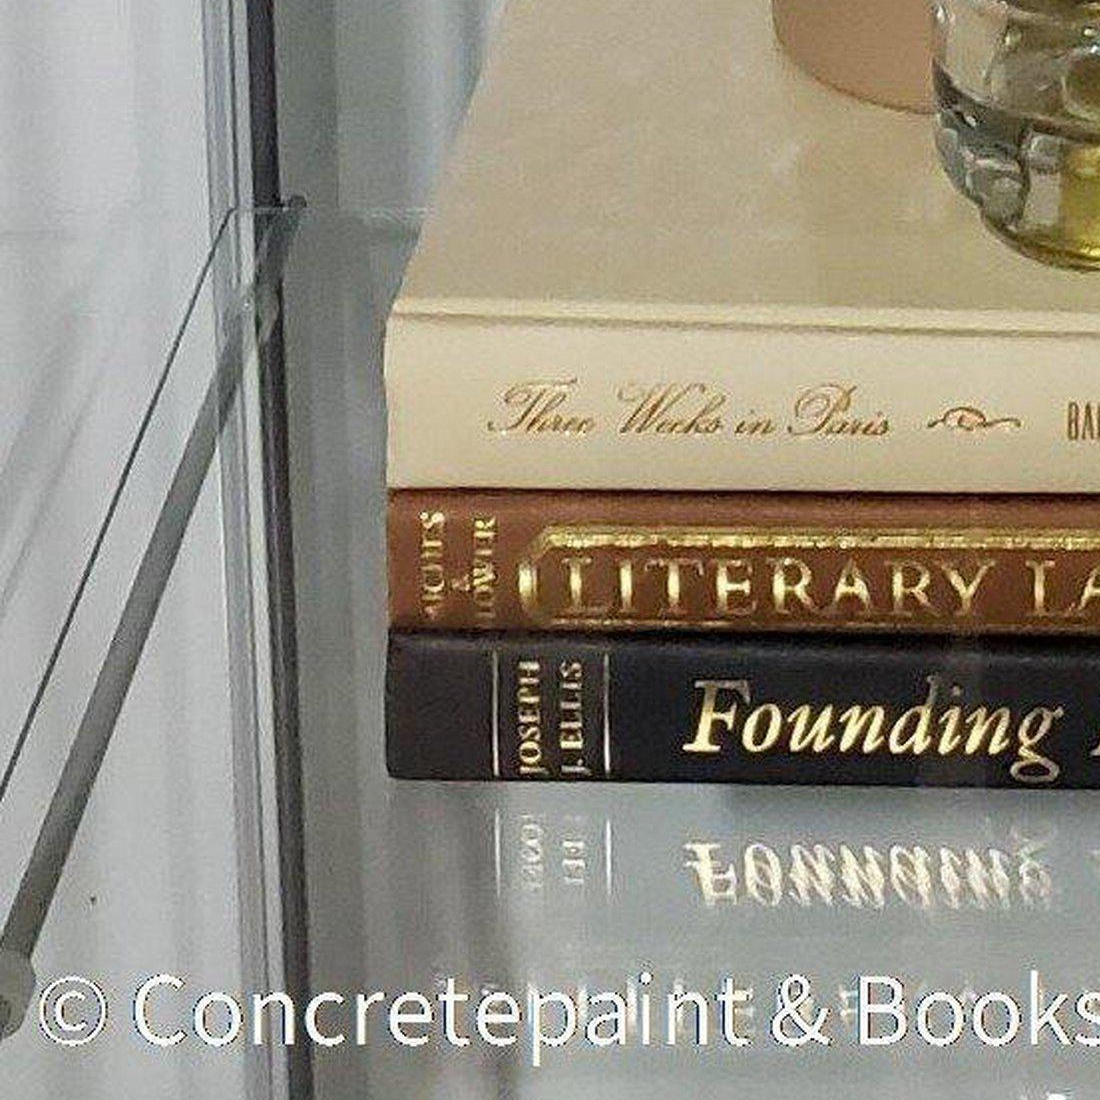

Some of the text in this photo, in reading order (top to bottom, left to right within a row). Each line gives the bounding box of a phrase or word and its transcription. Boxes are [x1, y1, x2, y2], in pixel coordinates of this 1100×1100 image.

[487, 376, 893, 437] Three Weeks in Paris
[561, 555, 996, 617] LITERARY
[517, 660, 548, 775] JOSEPH
[559, 660, 591, 776] J. ELLIS
[682, 674, 1064, 782] Founding
